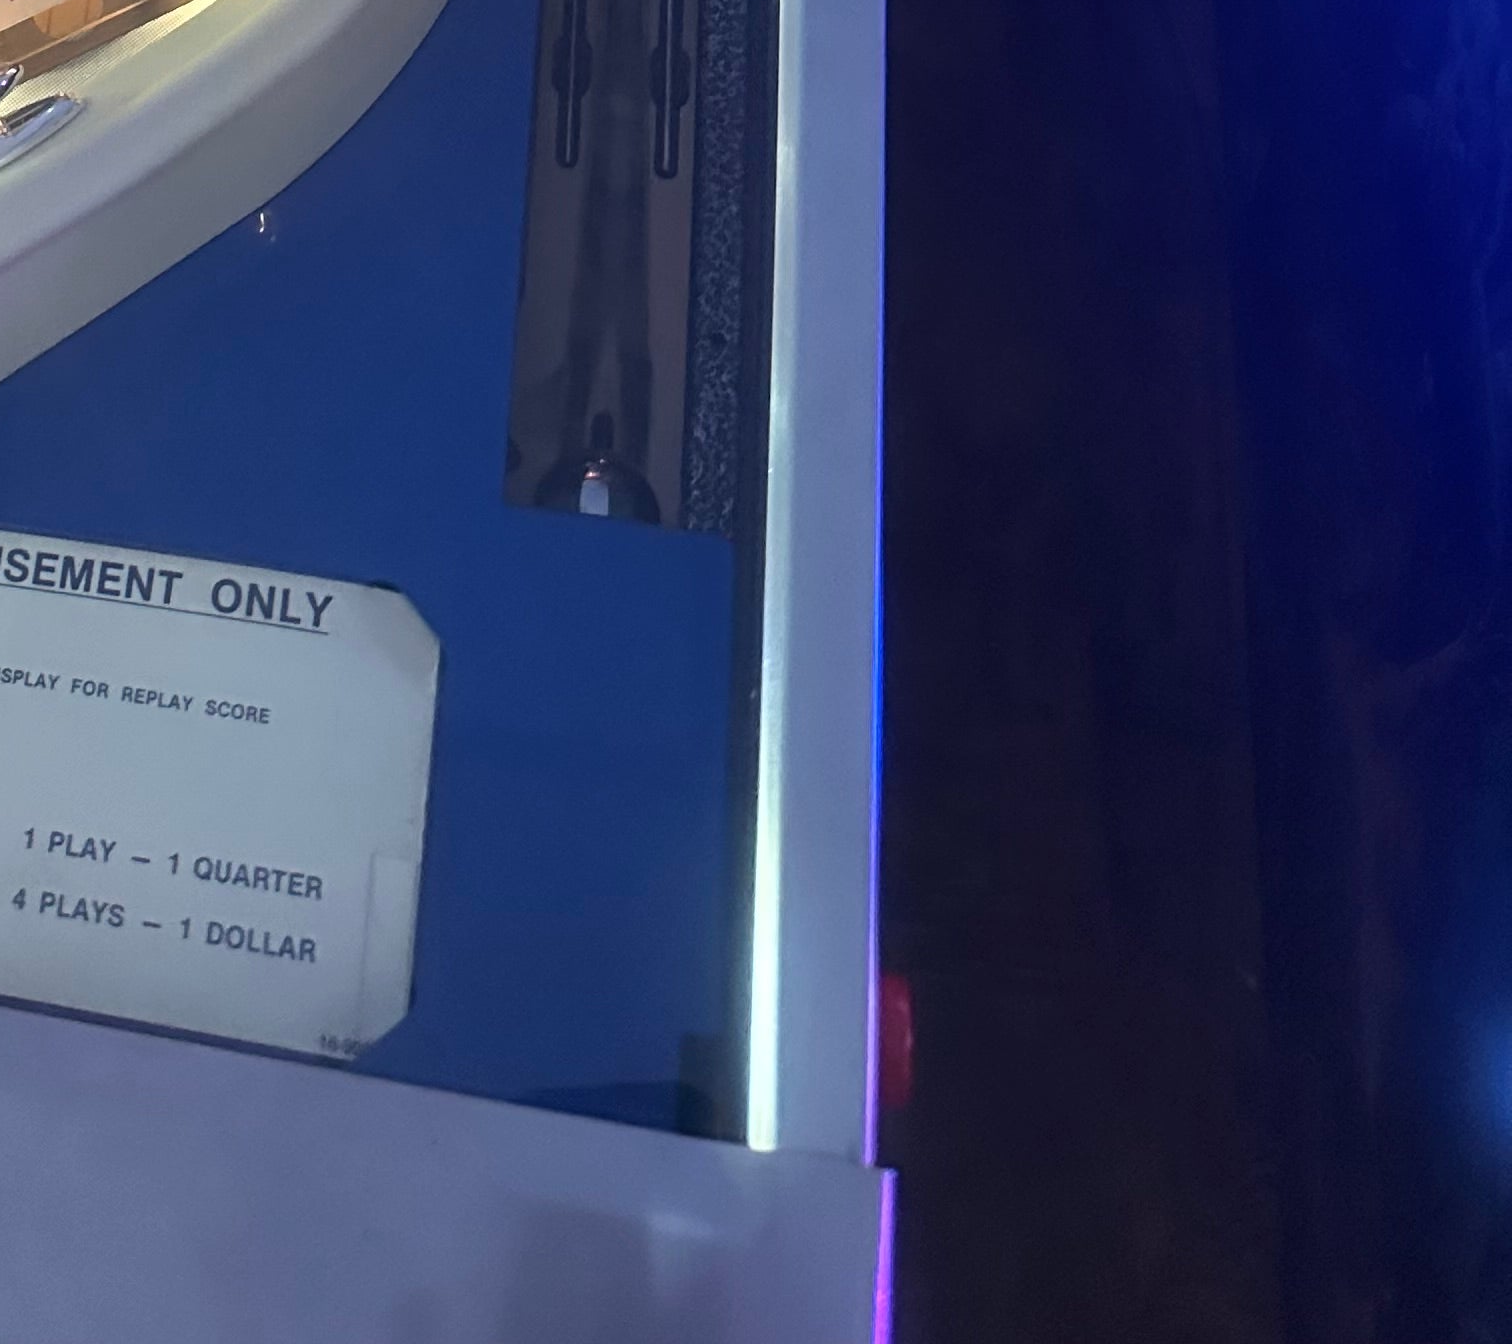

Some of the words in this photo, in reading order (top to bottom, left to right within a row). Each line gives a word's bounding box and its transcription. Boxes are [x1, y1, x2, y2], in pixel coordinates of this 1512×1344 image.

[209, 578, 334, 629] ONLY
[71, 677, 111, 700] FOR
[121, 684, 194, 715] REPLAY
[204, 698, 272, 726] SCORE
[23, 827, 36, 851] 1
[48, 831, 118, 866] PLAY
[168, 852, 181, 876] 1
[192, 855, 324, 902] QUARTER
[11, 888, 27, 914] 4
[39, 891, 126, 929] PLAYS
[180, 917, 193, 942] 1
[205, 920, 319, 965] DOLLAR
